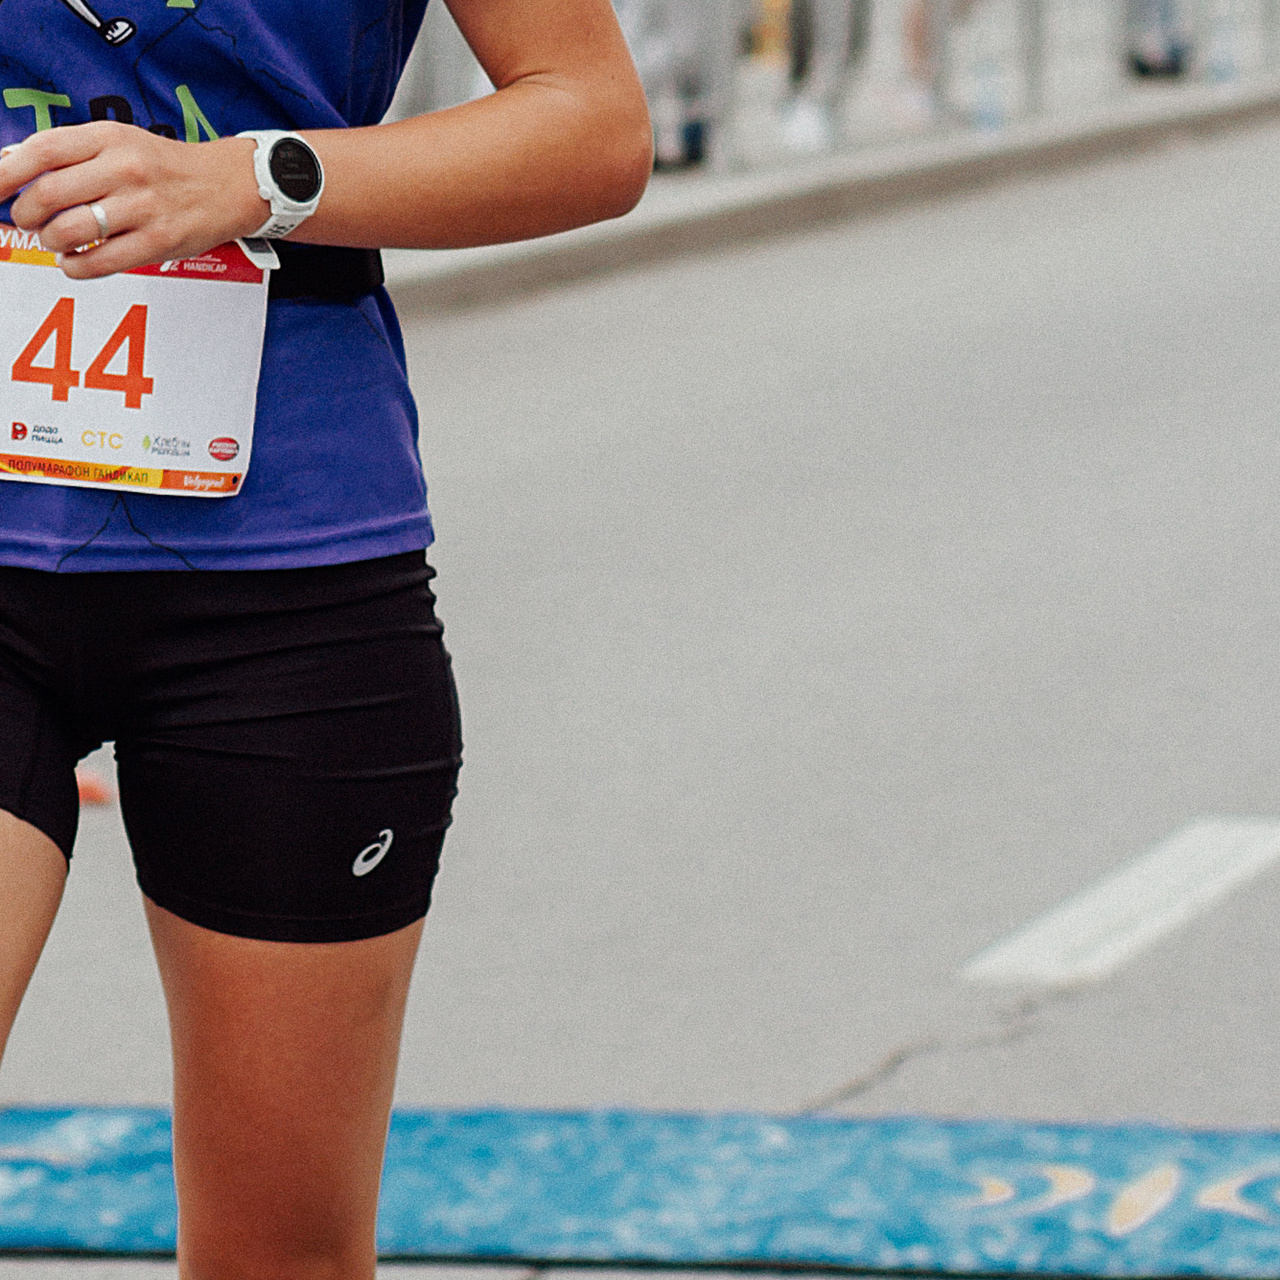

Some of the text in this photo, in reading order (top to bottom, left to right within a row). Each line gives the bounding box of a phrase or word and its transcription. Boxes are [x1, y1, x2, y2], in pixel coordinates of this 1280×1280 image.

[183, 261, 228, 273] HANDICAP
[11, 296, 155, 410] 44
[8, 459, 149, 484] ПОЛУМАРАФОН ГАНДИКАП
